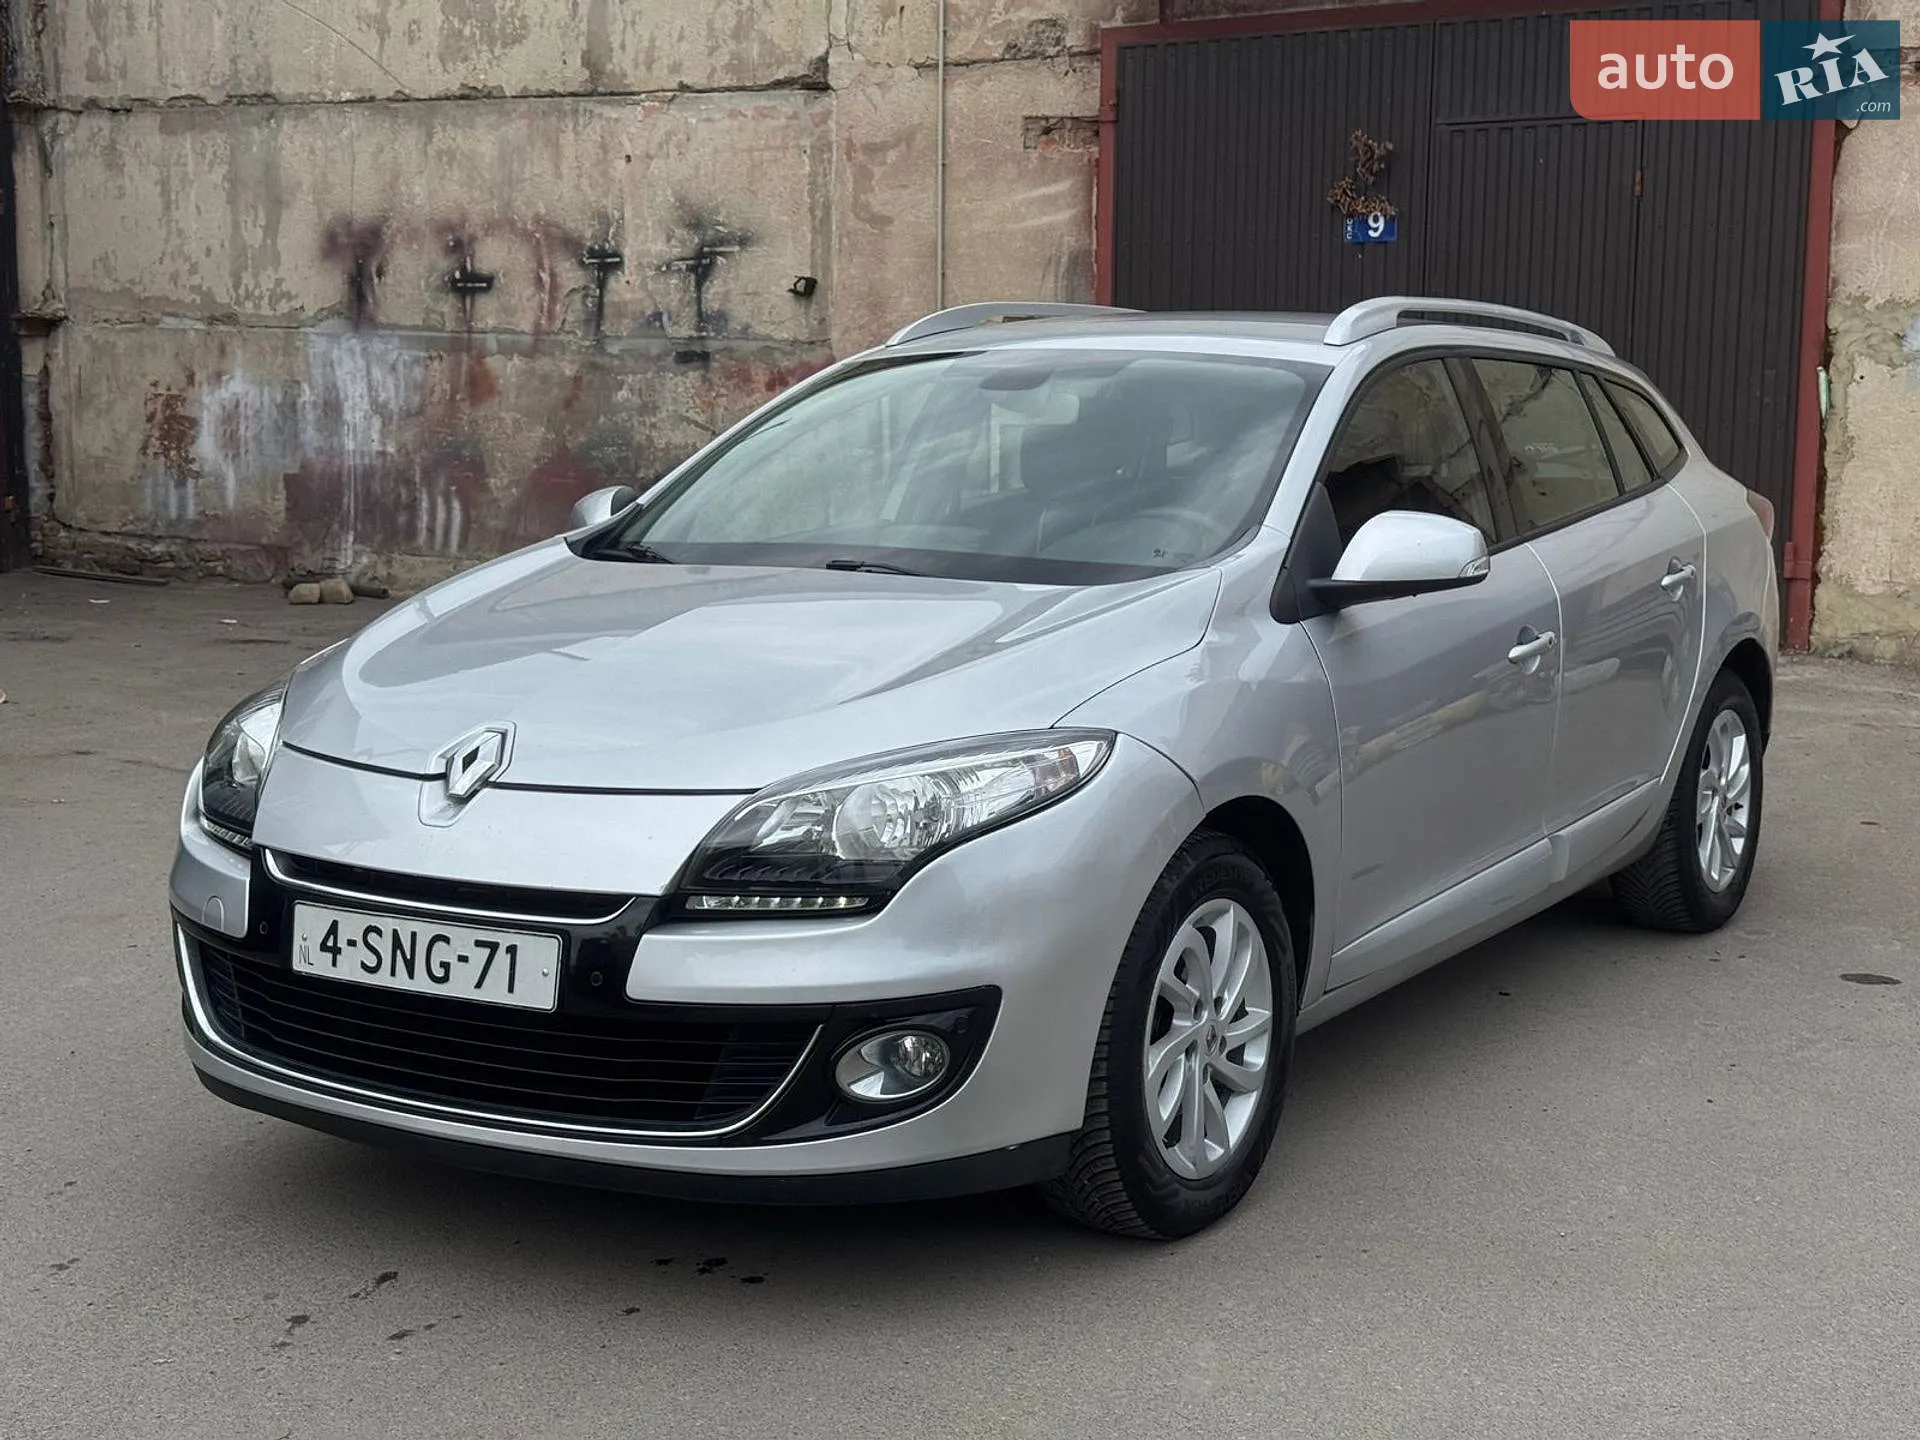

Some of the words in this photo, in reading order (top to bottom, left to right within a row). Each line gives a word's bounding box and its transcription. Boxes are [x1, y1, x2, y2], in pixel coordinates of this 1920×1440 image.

[1367, 211, 1385, 238] 9
[298, 944, 314, 966] NL
[319, 919, 518, 994] 4-SNG-71
